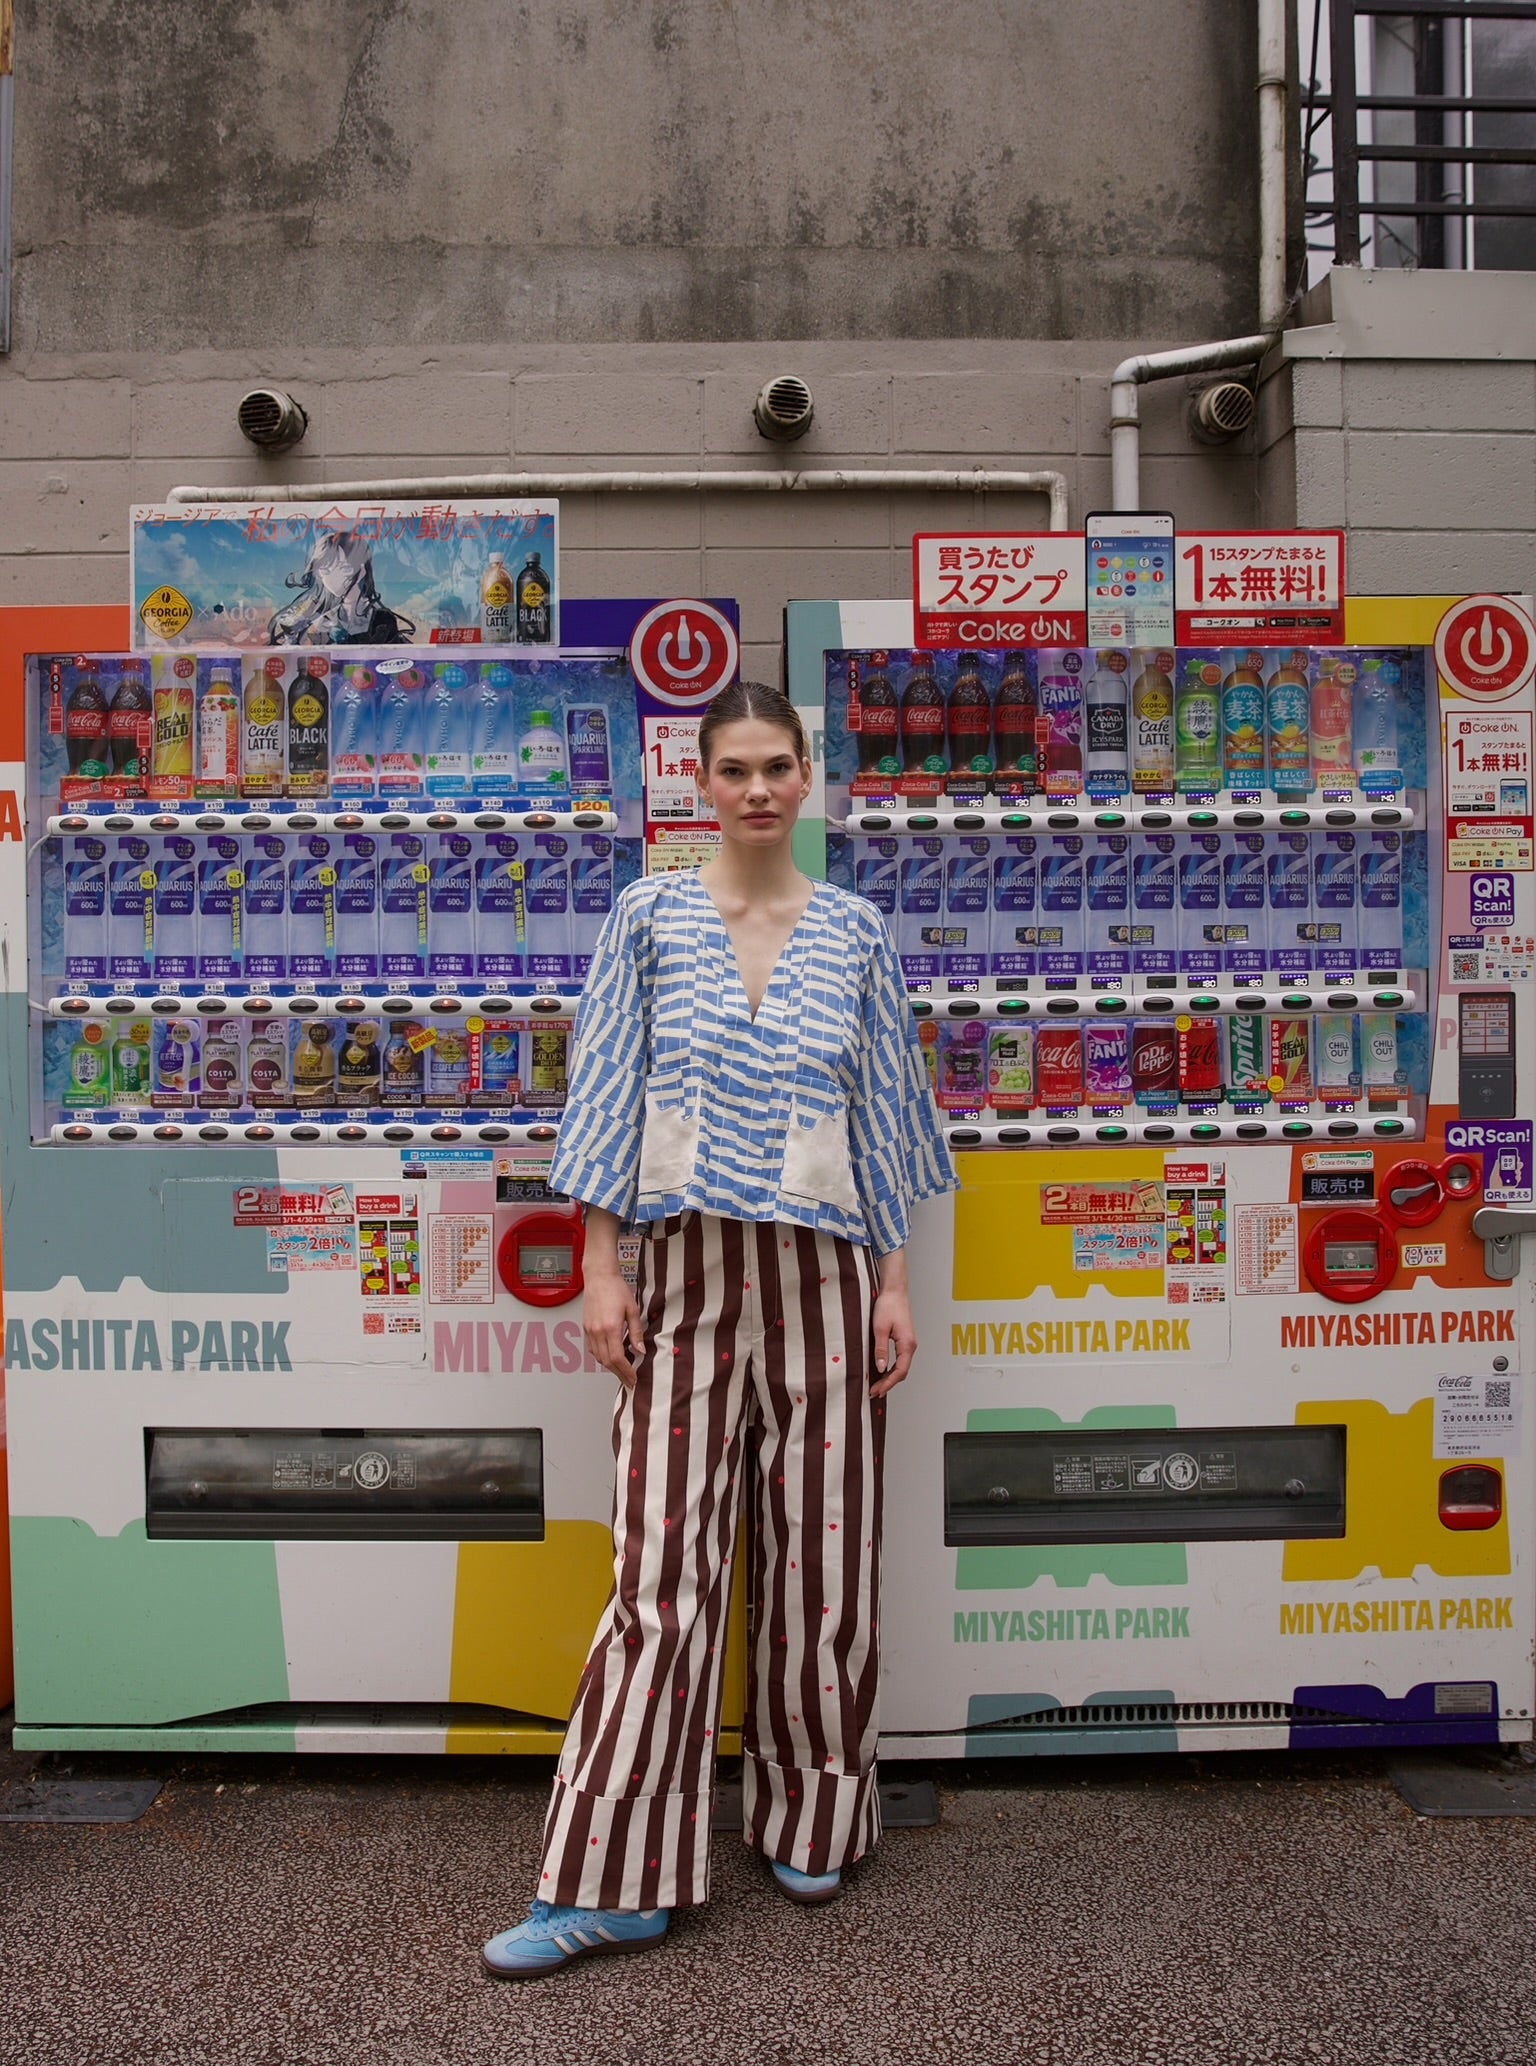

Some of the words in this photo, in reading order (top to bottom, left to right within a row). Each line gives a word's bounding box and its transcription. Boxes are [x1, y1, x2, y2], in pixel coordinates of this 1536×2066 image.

[938, 545, 1034, 571] 買うたび
[1210, 548, 1326, 561] 15スタンプたまると
[937, 569, 1068, 605] スタンプ
[144, 607, 190, 617] GEORGIA
[486, 606, 509, 616] Café
[520, 609, 547, 622] BLACK
[154, 618, 180, 627] Coffee
[486, 617, 509, 627] LATTE
[958, 620, 1025, 642] Coke
[1031, 615, 1071, 641] ON
[1247, 658, 1262, 667] 650
[670, 681, 688, 689] Coke
[1042, 687, 1081, 704] FANTA
[907, 708, 942, 723] Coca-Cola
[1226, 700, 1263, 720] 麦茶
[1271, 700, 1307, 720] 麦茶
[157, 712, 188, 728] REAL
[862, 709, 895, 724] Coca-Cola
[248, 725, 278, 737] Café
[671, 728, 696, 736] Coke
[1139, 720, 1169, 732] Café
[1473, 723, 1499, 733] Coke
[1501, 722, 1518, 732] ON
[156, 727, 188, 742] GOLD
[290, 727, 327, 744] BLACK
[1139, 733, 1169, 746] LATTE
[248, 738, 278, 750] LATTE
[668, 833, 688, 841] Coke
[690, 832, 703, 840] ON
[704, 833, 720, 841] Pay
[1470, 827, 1491, 835] Coke
[1492, 826, 1505, 835] ON
[1506, 827, 1522, 836] Pay
[66, 881, 104, 892] AQUARIUS
[156, 881, 194, 891] AQUARIUS
[245, 880, 283, 890] AQUARIUS
[336, 879, 374, 890] AQUARIUS
[430, 878, 470, 889] AQUARIUS
[1473, 878, 1511, 898] QR
[1474, 900, 1511, 911] Scan!
[1272, 1023, 1280, 1073] お手頃価格!
[1281, 1038, 1304, 1050] REAL
[1328, 1041, 1349, 1050] CHILL
[1373, 1040, 1394, 1048] CHILL
[534, 1053, 566, 1061] GOLDEN
[1151, 1046, 1165, 1058] Dr
[1280, 1047, 1306, 1061] GOLD
[1330, 1049, 1348, 1057] OUT
[1375, 1047, 1392, 1055] OUT
[1179, 1034, 1187, 1084] お手頃価格!
[387, 1072, 399, 1080] ICE
[400, 1072, 419, 1080] COCOA
[1448, 1127, 1485, 1147] QR
[1486, 1129, 1530, 1143] Scan!
[1311, 1178, 1365, 1194] 販売中
[1486, 1191, 1530, 1200] QRも使える
[1281, 1312, 1436, 1348] MIYASHITA
[1441, 1310, 1515, 1343] PARK
[952, 1321, 1110, 1356] MIYASHITA
[1114, 1319, 1191, 1352] PARK
[172, 1320, 293, 1372] PARK
[1280, 1600, 1435, 1635] MIYASHITA
[1439, 1597, 1514, 1630] PARK
[954, 1608, 1112, 1643] MIYASHITA
[1115, 1607, 1190, 1639] PARK
